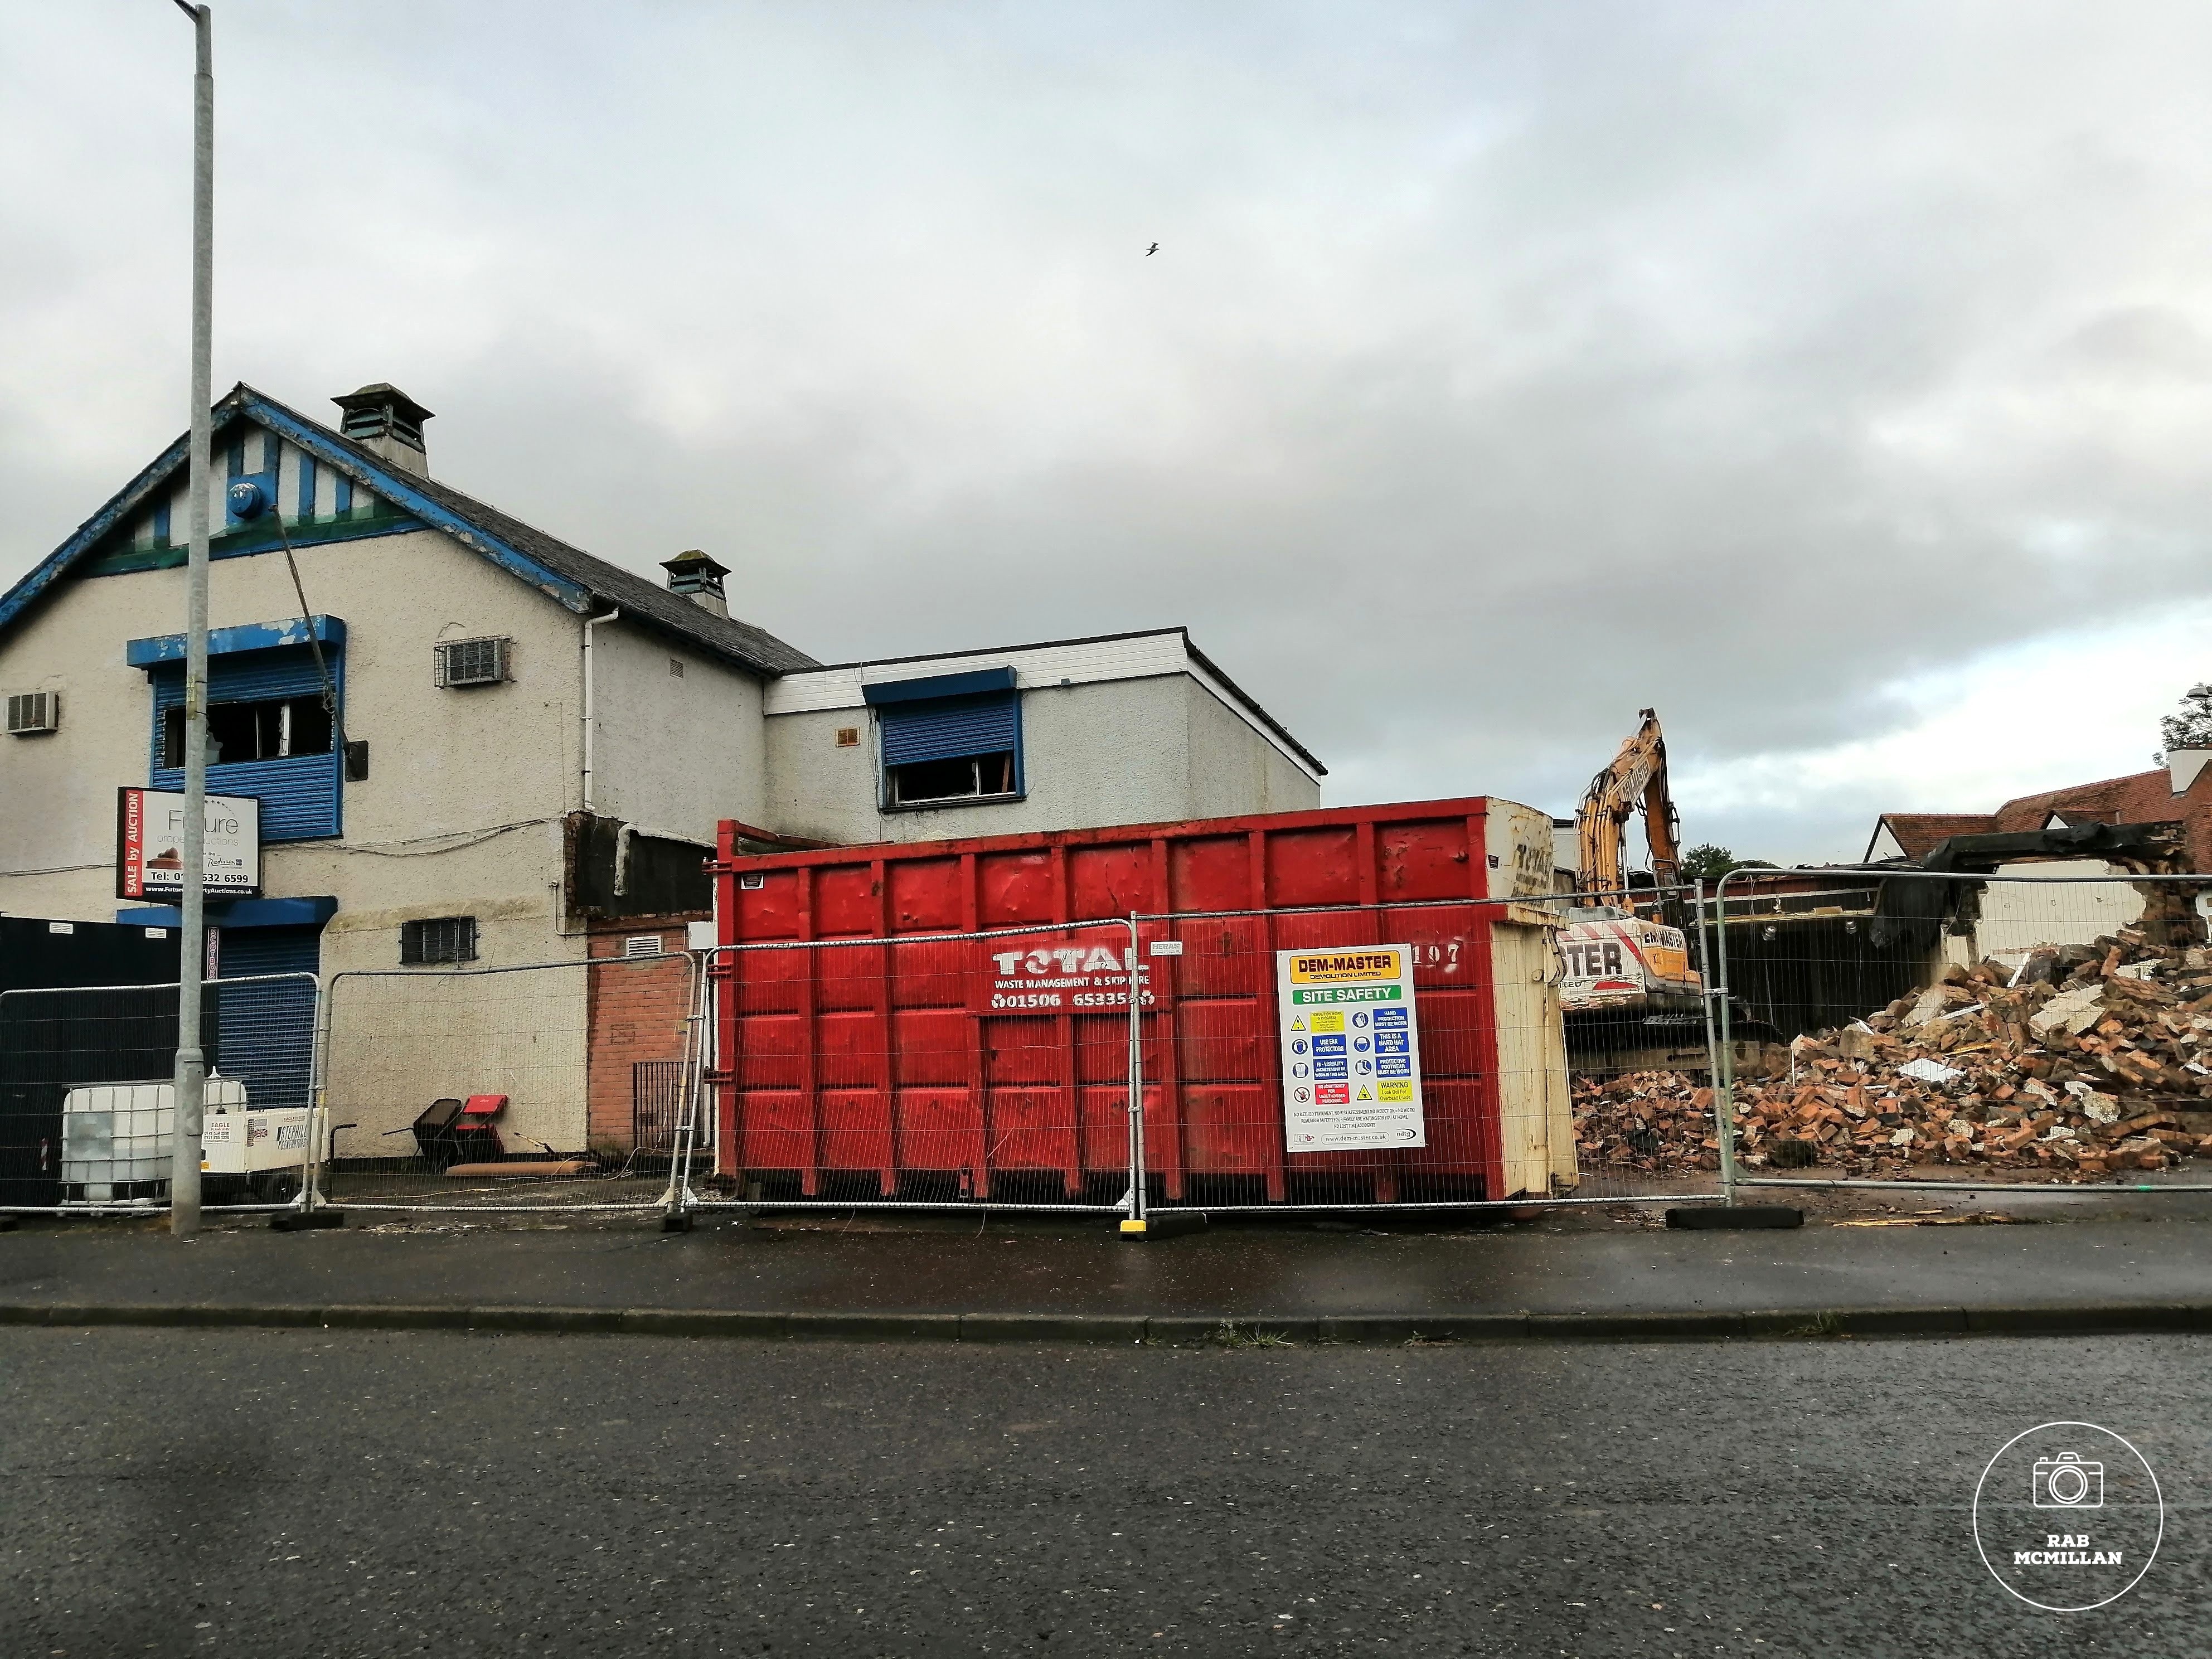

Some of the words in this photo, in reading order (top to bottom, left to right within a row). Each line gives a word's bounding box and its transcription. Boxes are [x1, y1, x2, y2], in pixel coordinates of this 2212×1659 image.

[128, 793, 138, 842] AUCTION
[168, 810, 239, 834] Fure
[128, 846, 140, 861] by
[127, 865, 137, 893] SALE
[151, 872, 169, 880] Tel:
[224, 875, 249, 883] 6599
[992, 948, 1149, 974] TOTAL
[1298, 955, 1391, 973] DEM-MASTER
[995, 980, 1024, 988] WASTE
[1026, 977, 1090, 988] MANAGEMENT
[1094, 977, 1103, 986] &
[1104, 976, 1126, 986] SKIP
[1006, 994, 1060, 1008] 01506
[1302, 990, 1333, 1003] SITE
[1336, 987, 1391, 1001] SAFETY
[1325, 1133, 1386, 1142] www.dem-master.co.uk
